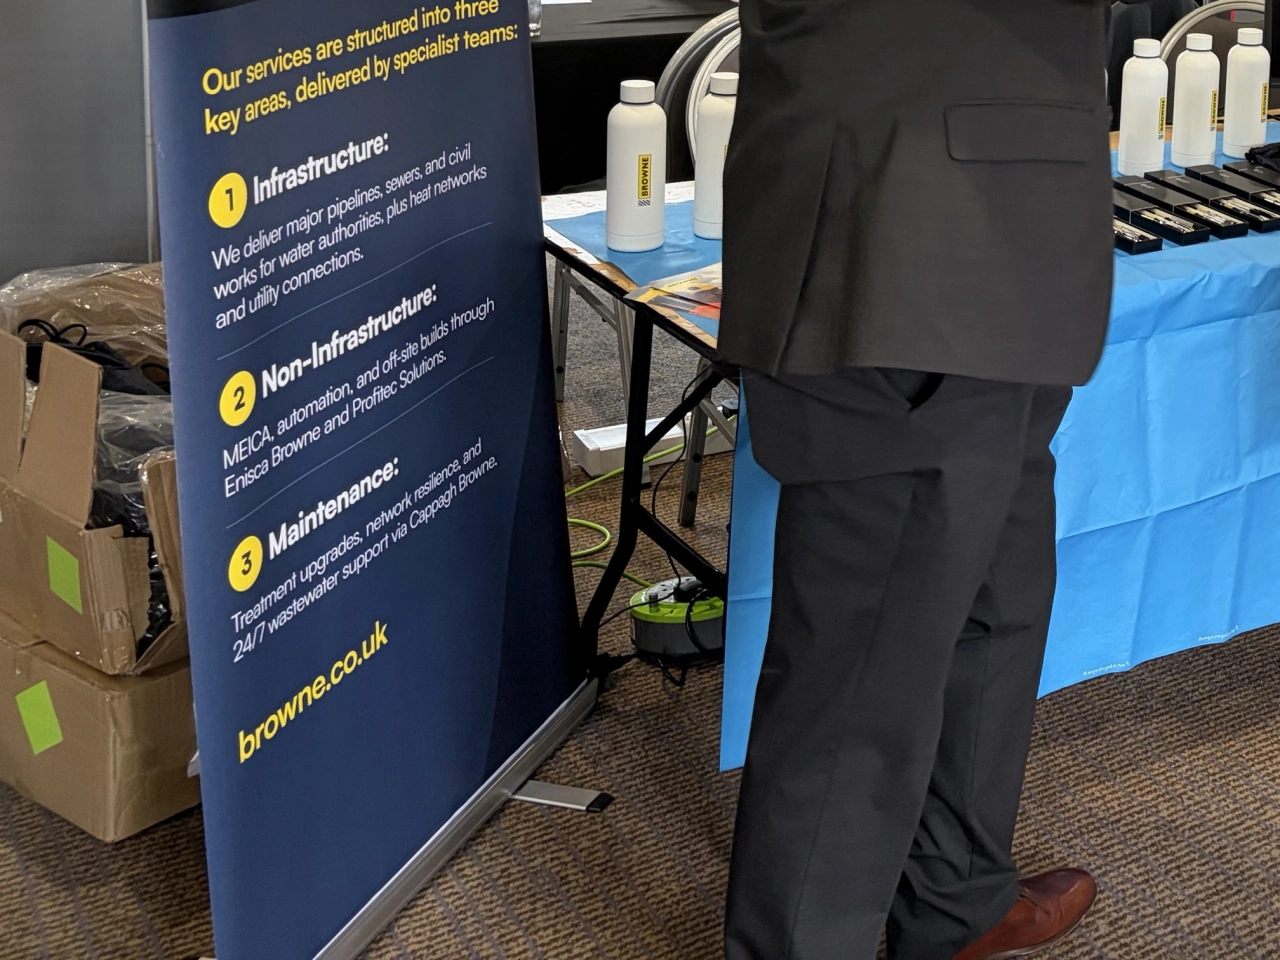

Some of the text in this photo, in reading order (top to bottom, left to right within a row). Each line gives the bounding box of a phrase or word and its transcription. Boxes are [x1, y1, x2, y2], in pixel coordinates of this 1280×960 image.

[202, 67, 242, 95] Our
[246, 49, 312, 84] services
[315, 39, 343, 60] are
[347, 9, 419, 52] structured
[422, 4, 451, 30] into
[204, 24, 518, 135] key areas, delivered by specialist teams:
[211, 142, 471, 270] We deliver major pipelines, sewers, and civil
[214, 164, 487, 300] works for water authorities, plus heat networks
[225, 132, 389, 212] 1 Infrastructure:
[641, 156, 649, 197] BROWNE
[216, 245, 364, 329] and utility connections.
[234, 284, 437, 411] 2 Non-Infrastructure:
[222, 297, 495, 469] MEICA, automation, and off-site builds through
[224, 350, 447, 498] Enisca Browne and Profitec Solutions.
[231, 438, 482, 633] Treatment upgrades, network resilience, and
[233, 455, 498, 663] 24/7 wastewater support via Cappagh Browne.
[241, 457, 399, 576] 3 Maintenance:
[239, 620, 389, 763] browne.co.uk
